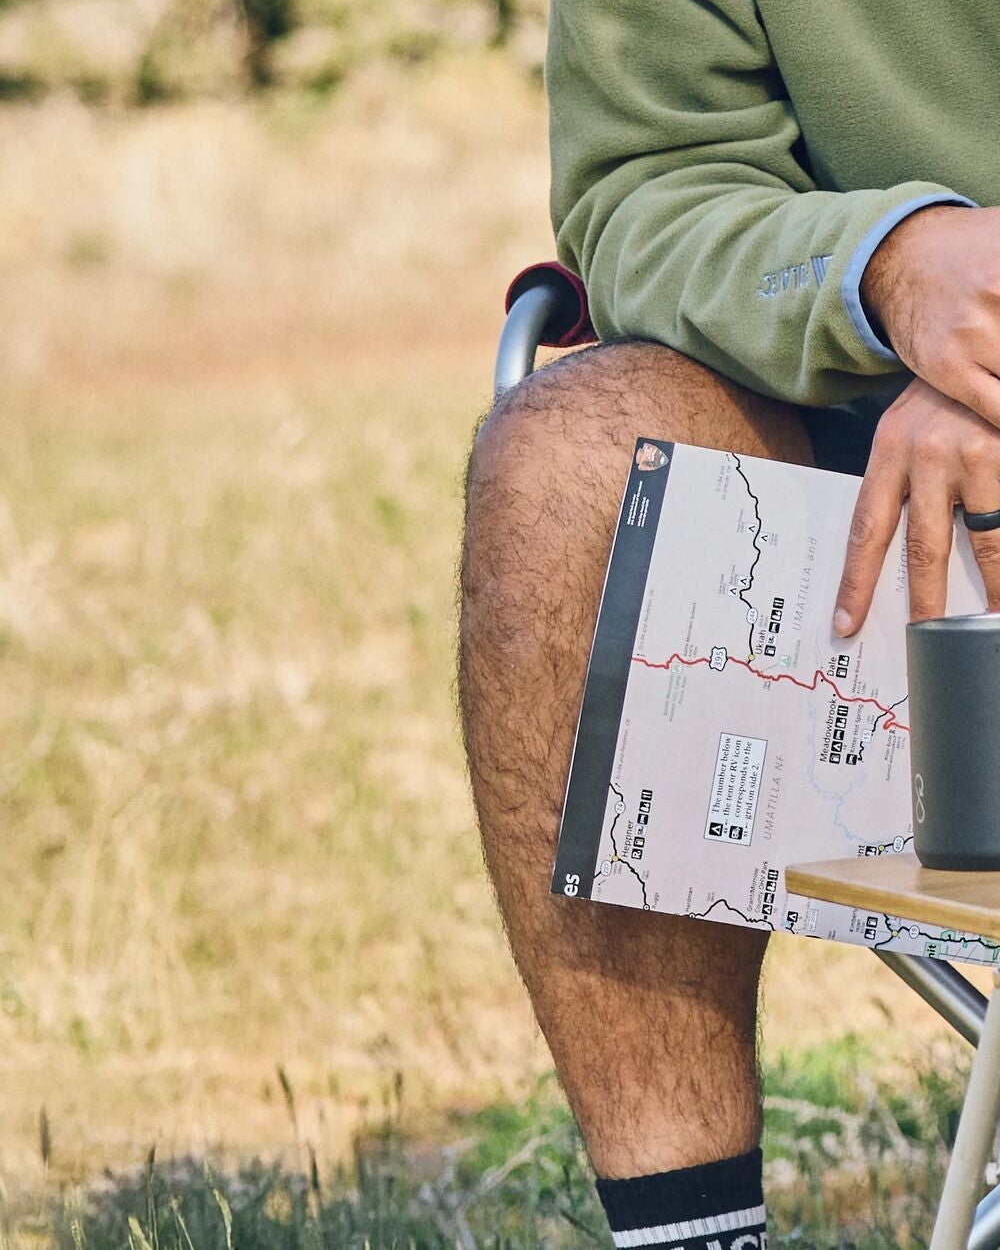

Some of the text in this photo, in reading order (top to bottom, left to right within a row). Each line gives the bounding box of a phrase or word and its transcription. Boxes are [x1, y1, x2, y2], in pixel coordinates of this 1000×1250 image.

[791, 566, 812, 631] UMATILLA
[803, 535, 817, 561] and
[713, 650, 723, 666] 395
[754, 628, 766, 655] Ukiah
[826, 655, 837, 676] Dale
[819, 698, 837, 762] Meadowbrook
[849, 736, 857, 753] Ritter
[855, 703, 864, 723] Spring
[711, 736, 731, 813] The number below
[722, 738, 742, 815] the tent or RV icon
[732, 740, 752, 817] corresponds to the
[743, 761, 759, 819] grid on side 2.
[761, 754, 784, 840] UMATILLA NF
[620, 819, 637, 857] Heppner
[760, 860, 768, 873] Park
[684, 886, 694, 912] Hardman
[910, 927, 918, 936] 19
